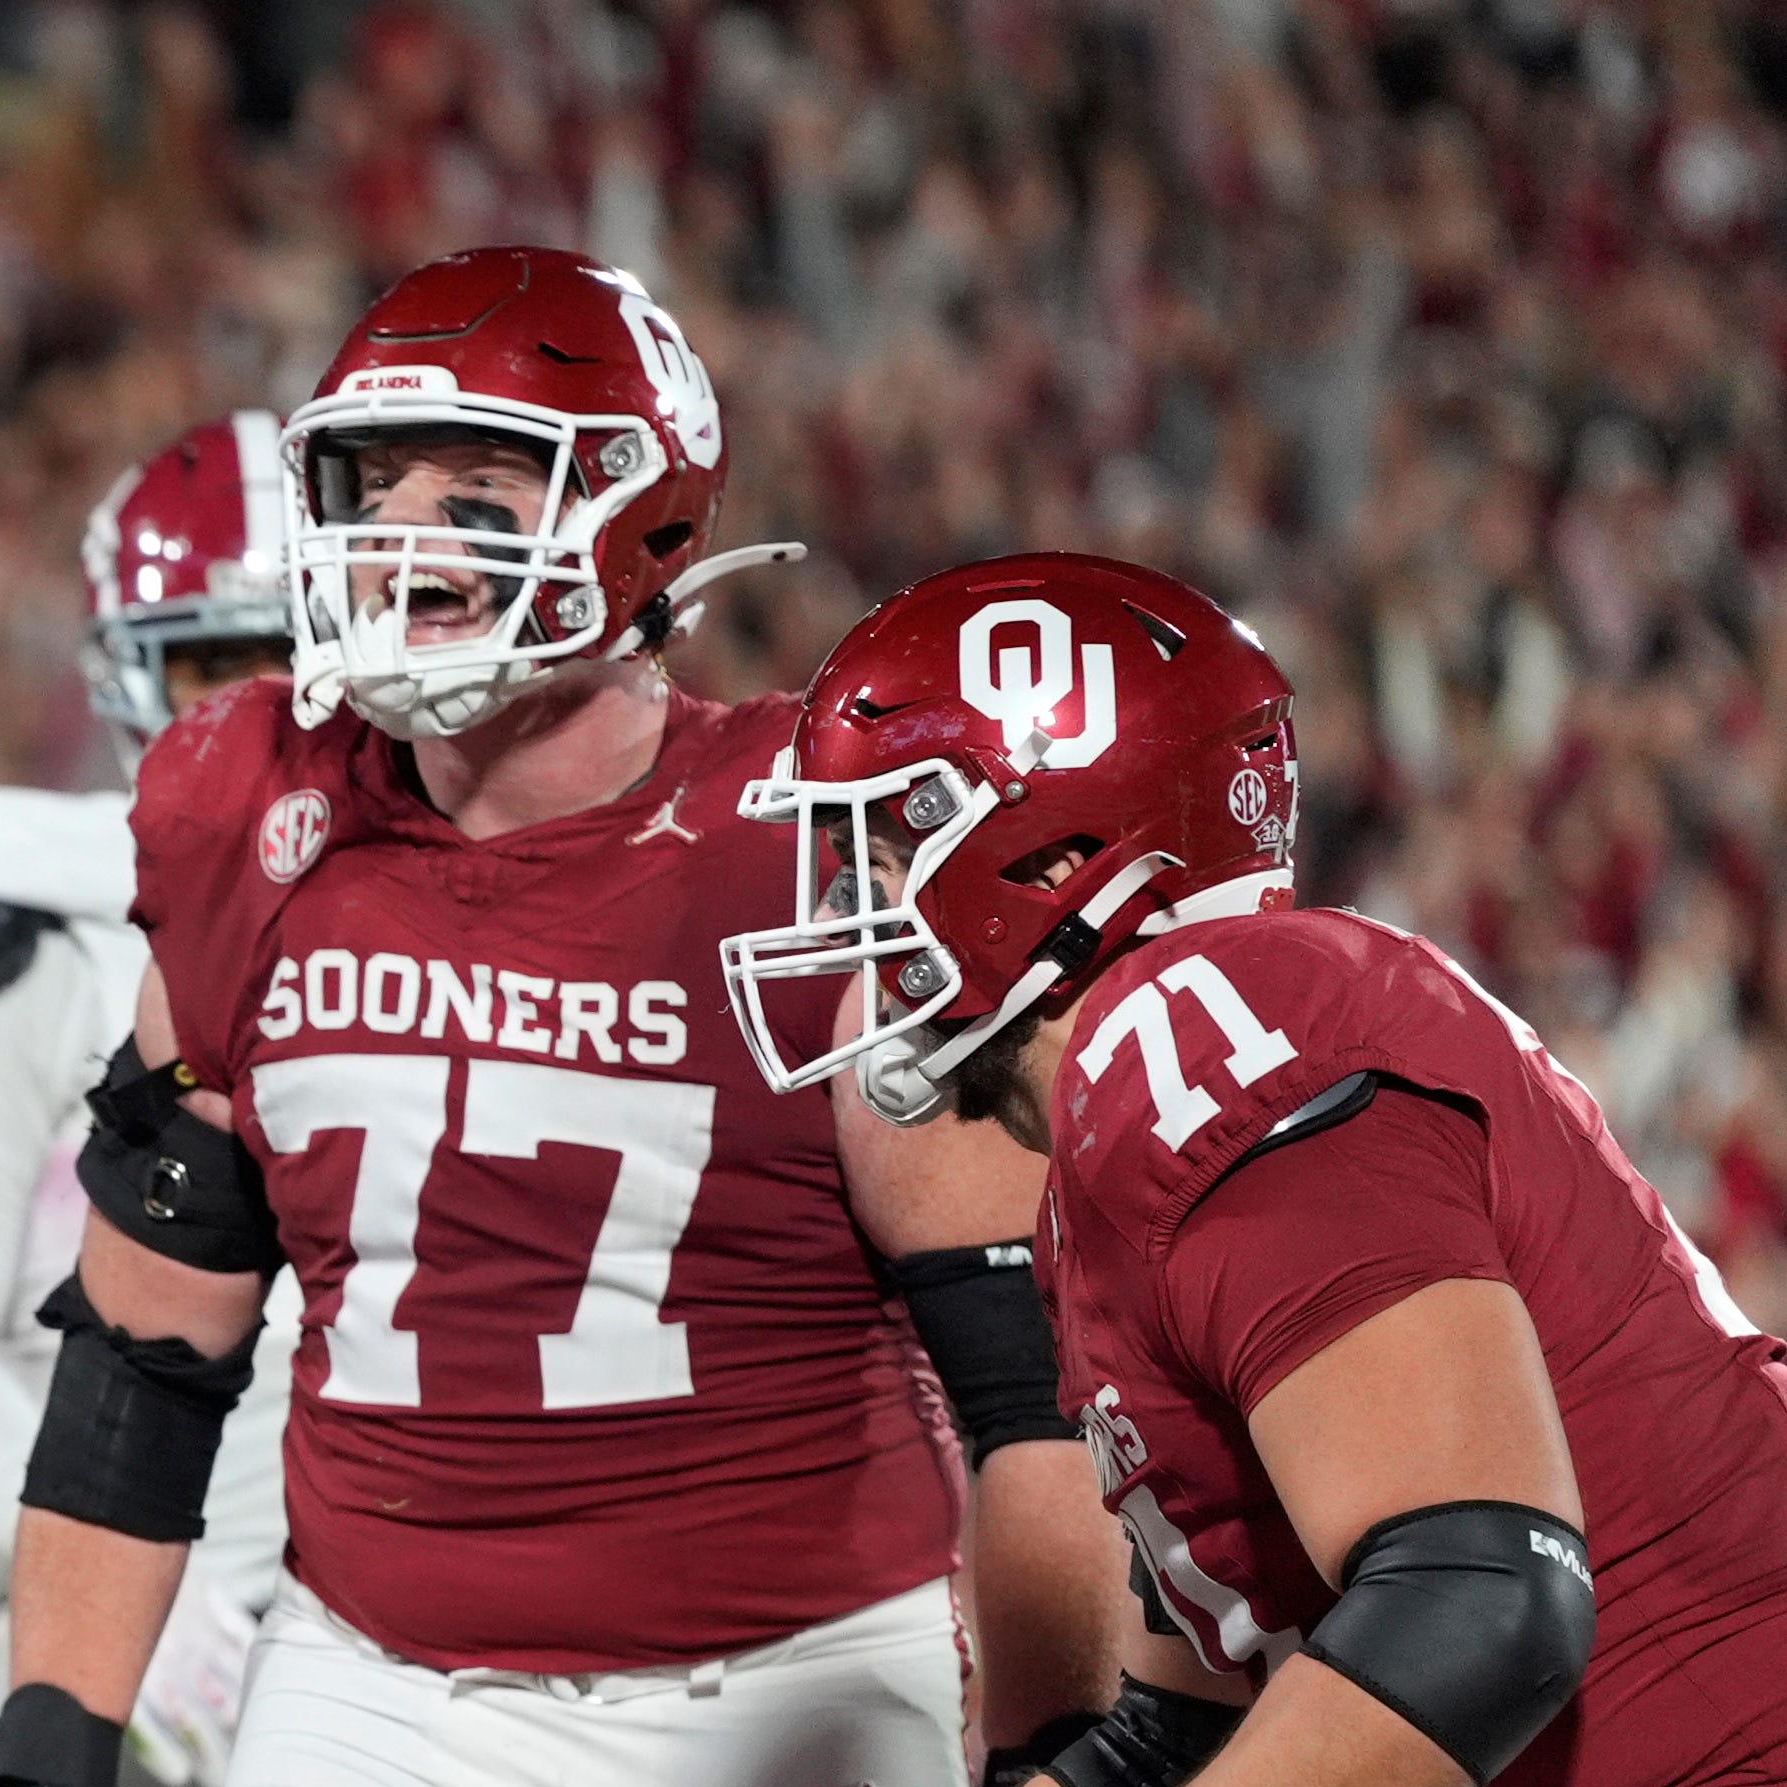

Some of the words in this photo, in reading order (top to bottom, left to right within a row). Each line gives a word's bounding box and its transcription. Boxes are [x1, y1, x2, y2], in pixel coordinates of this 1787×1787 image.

[959, 599, 1118, 772] OU
[265, 795, 325, 874] SEC
[1233, 772, 1262, 821] SEC
[256, 948, 688, 1066] SOONERS
[1076, 953, 1300, 1154] 71
[251, 1053, 717, 1410] 77
